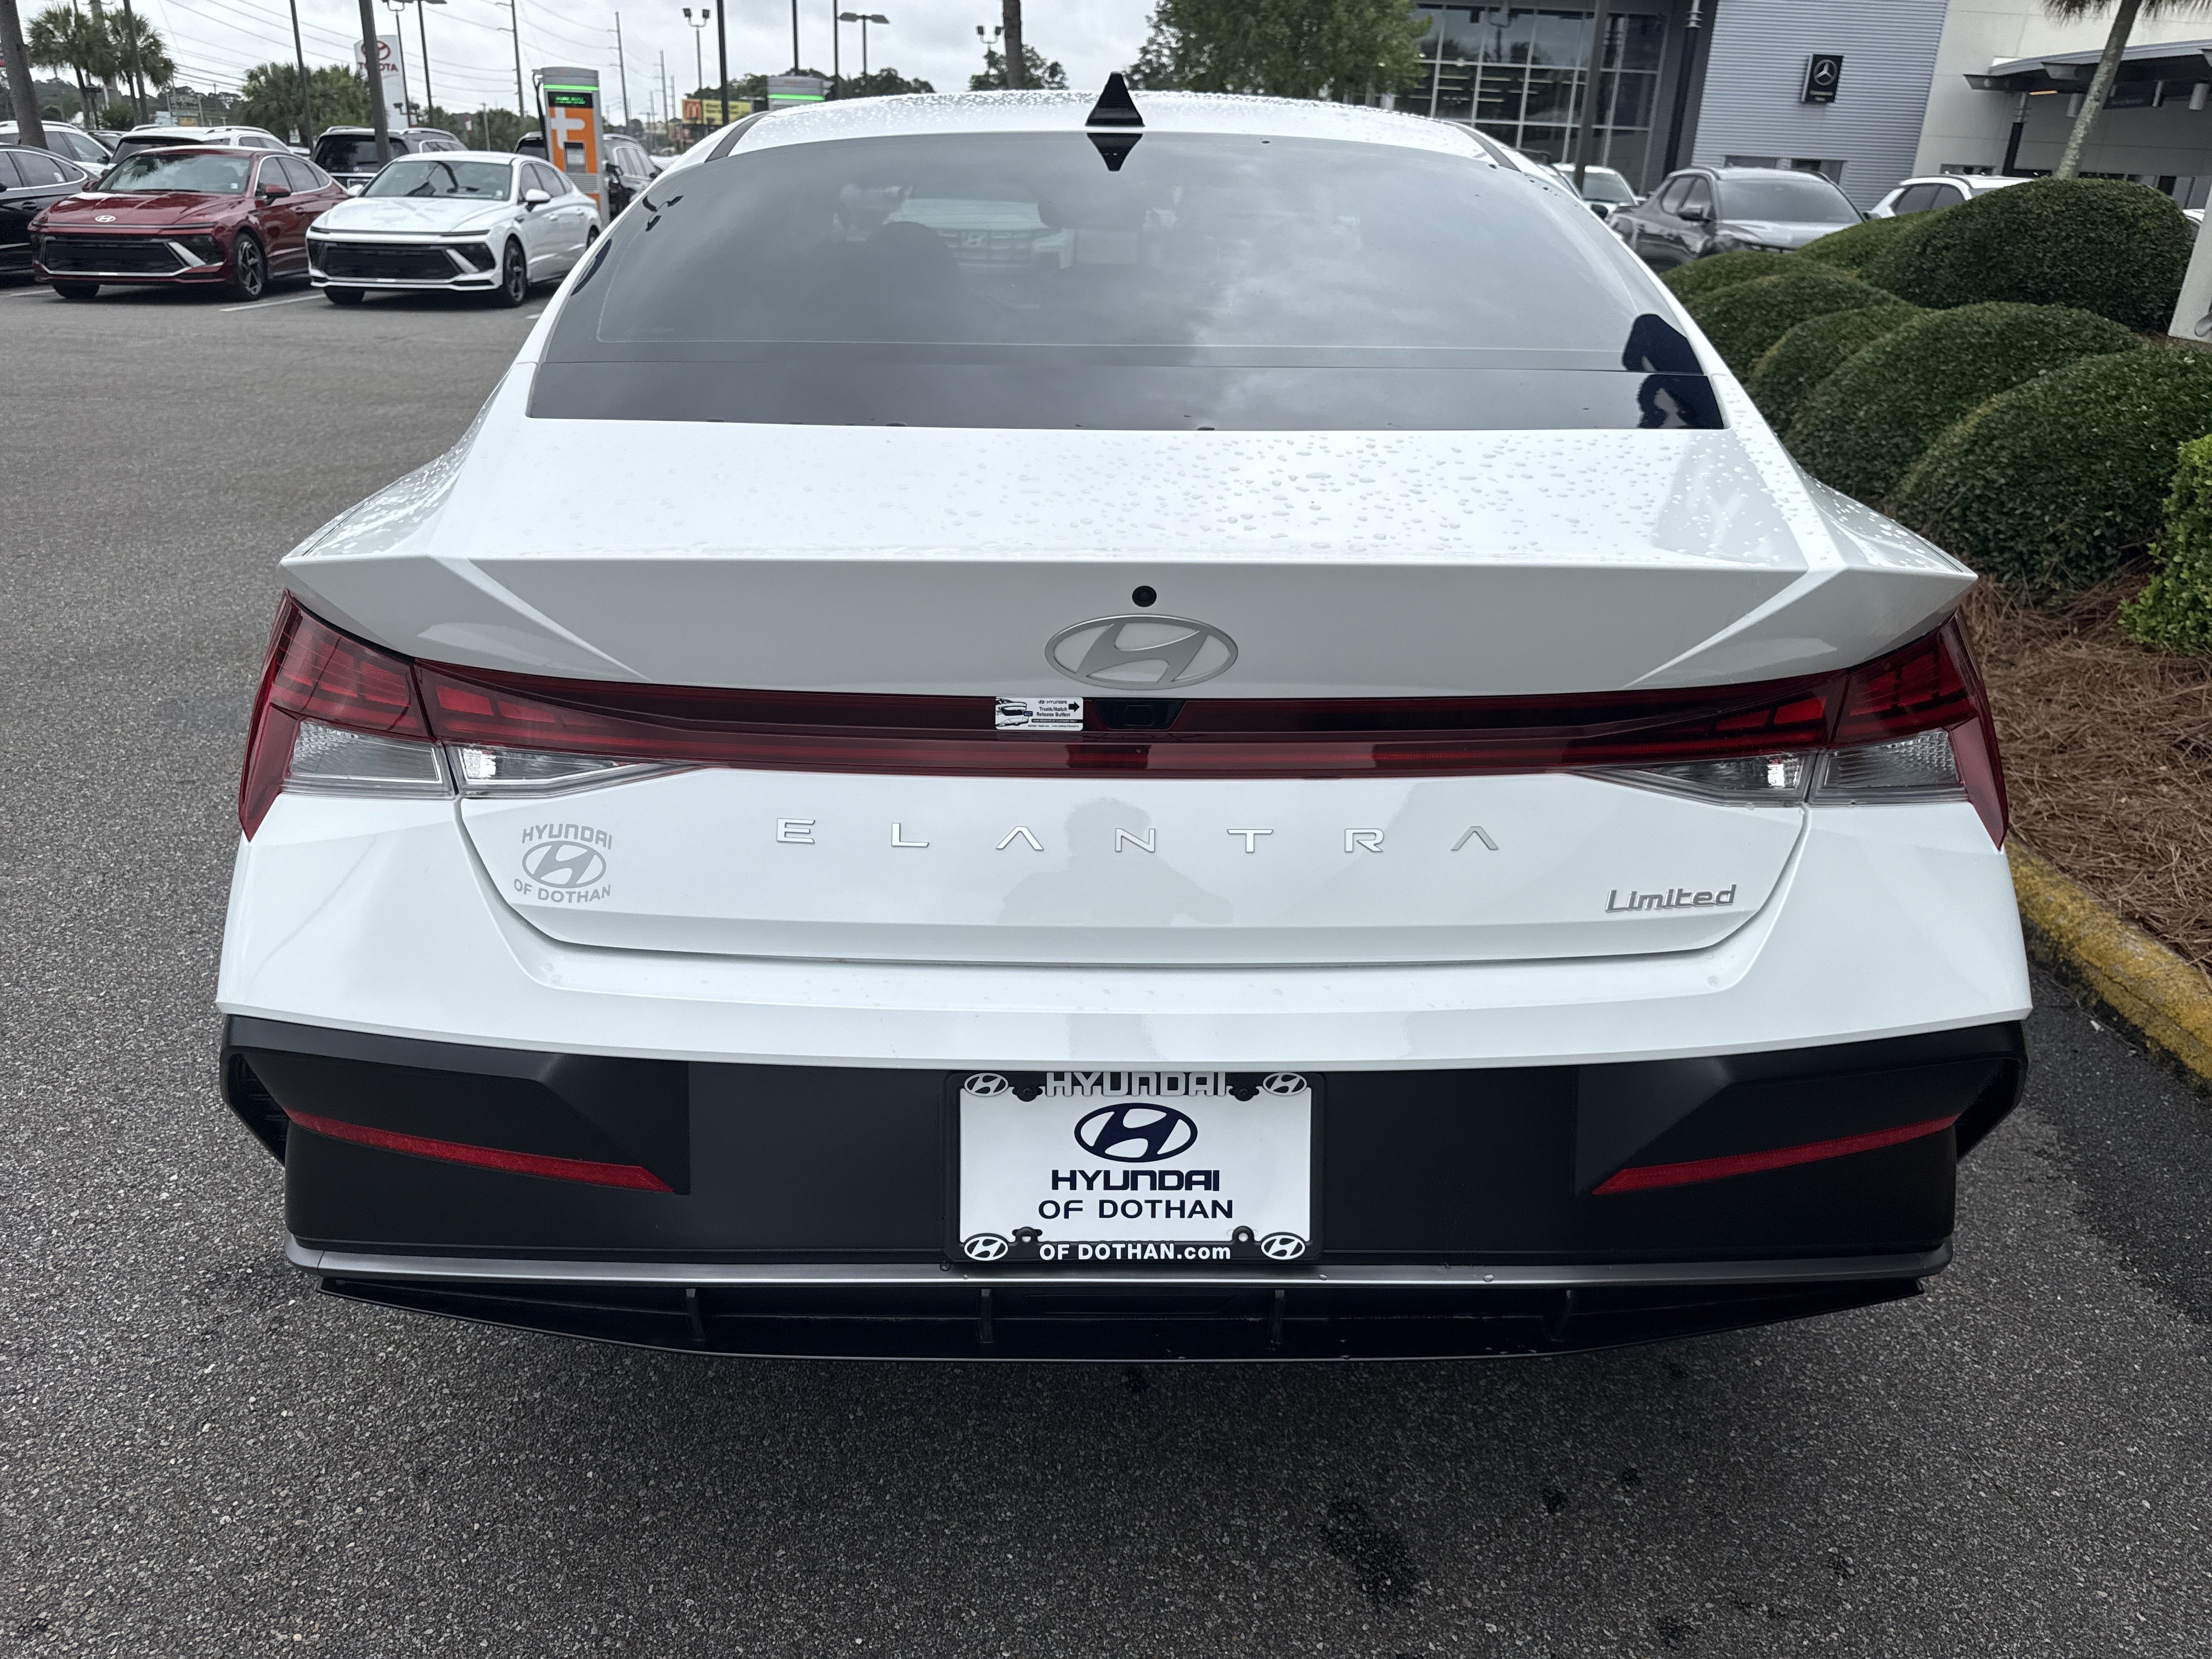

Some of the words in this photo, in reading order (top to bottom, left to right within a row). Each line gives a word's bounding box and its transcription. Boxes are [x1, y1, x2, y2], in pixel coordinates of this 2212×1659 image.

[357, 62, 398, 71] TOTA
[522, 823, 612, 850] HYUNDAI
[776, 817, 1499, 853] ELANTRA
[514, 878, 533, 895] OF
[538, 884, 611, 904] DOTHAN
[1605, 884, 1737, 912] Limited
[1046, 1071, 1227, 1097] HYUNDAI
[1052, 1170, 1220, 1191] HYUNDAI
[1039, 1200, 1083, 1219] OF
[1099, 1200, 1233, 1218] DOTHAN
[1040, 1244, 1070, 1260] OF
[1078, 1244, 1231, 1260] DOTHAN.com
